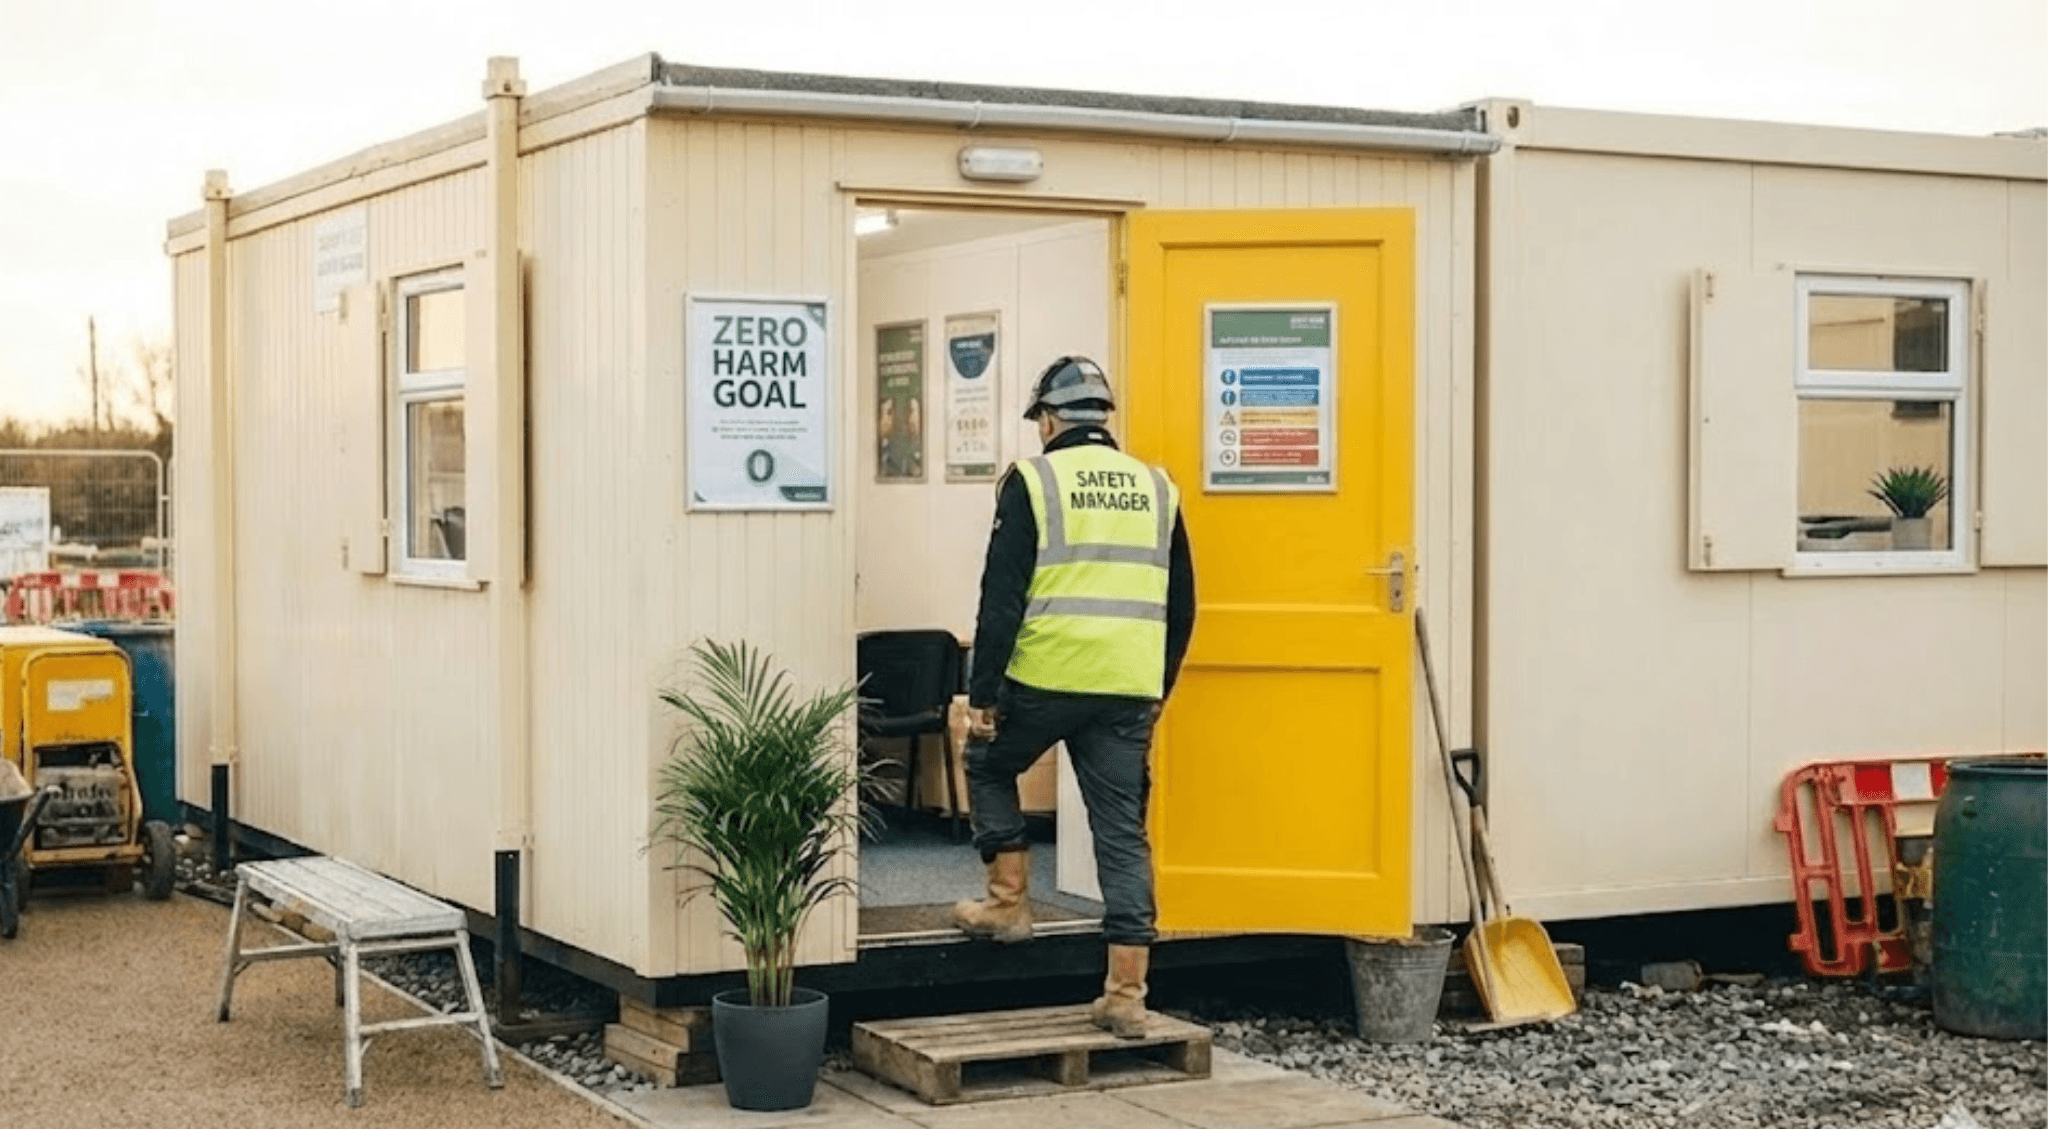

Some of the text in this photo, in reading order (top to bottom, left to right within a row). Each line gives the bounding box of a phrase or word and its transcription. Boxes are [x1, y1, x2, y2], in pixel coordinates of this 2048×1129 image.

[713, 315, 808, 347] ZERO
[713, 349, 806, 377] HARM
[713, 379, 807, 409] GOAL
[1075, 470, 1137, 488] SAFETY
